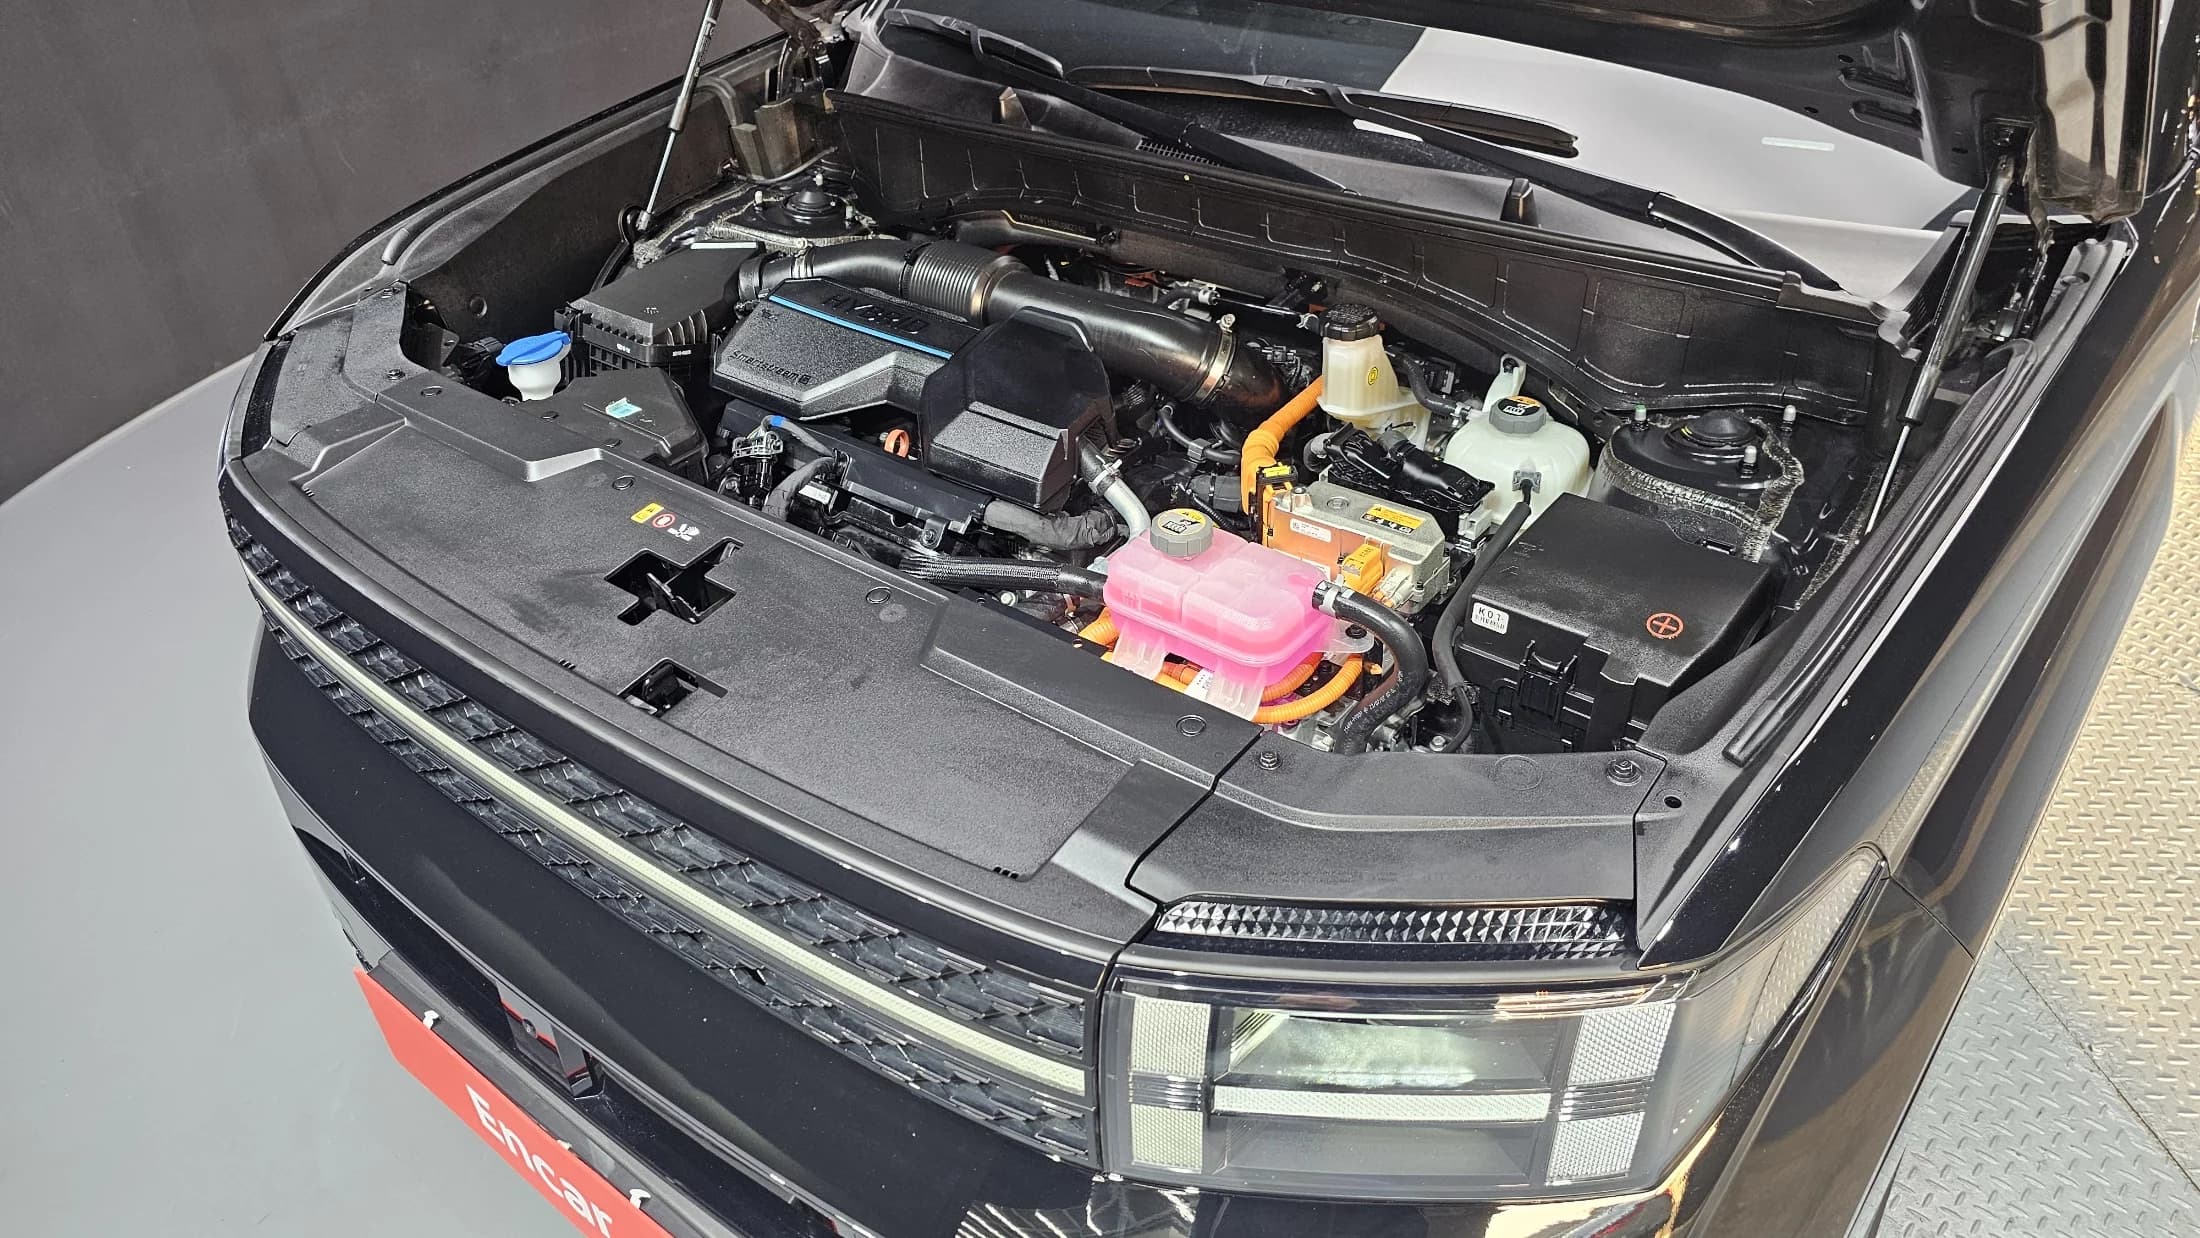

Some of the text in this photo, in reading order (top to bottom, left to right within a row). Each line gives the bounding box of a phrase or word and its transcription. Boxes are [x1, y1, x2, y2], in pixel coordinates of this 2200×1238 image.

[822, 295, 930, 335] HYBRID
[728, 350, 799, 380] Smartstream
[465, 1083, 613, 1238] Encar
